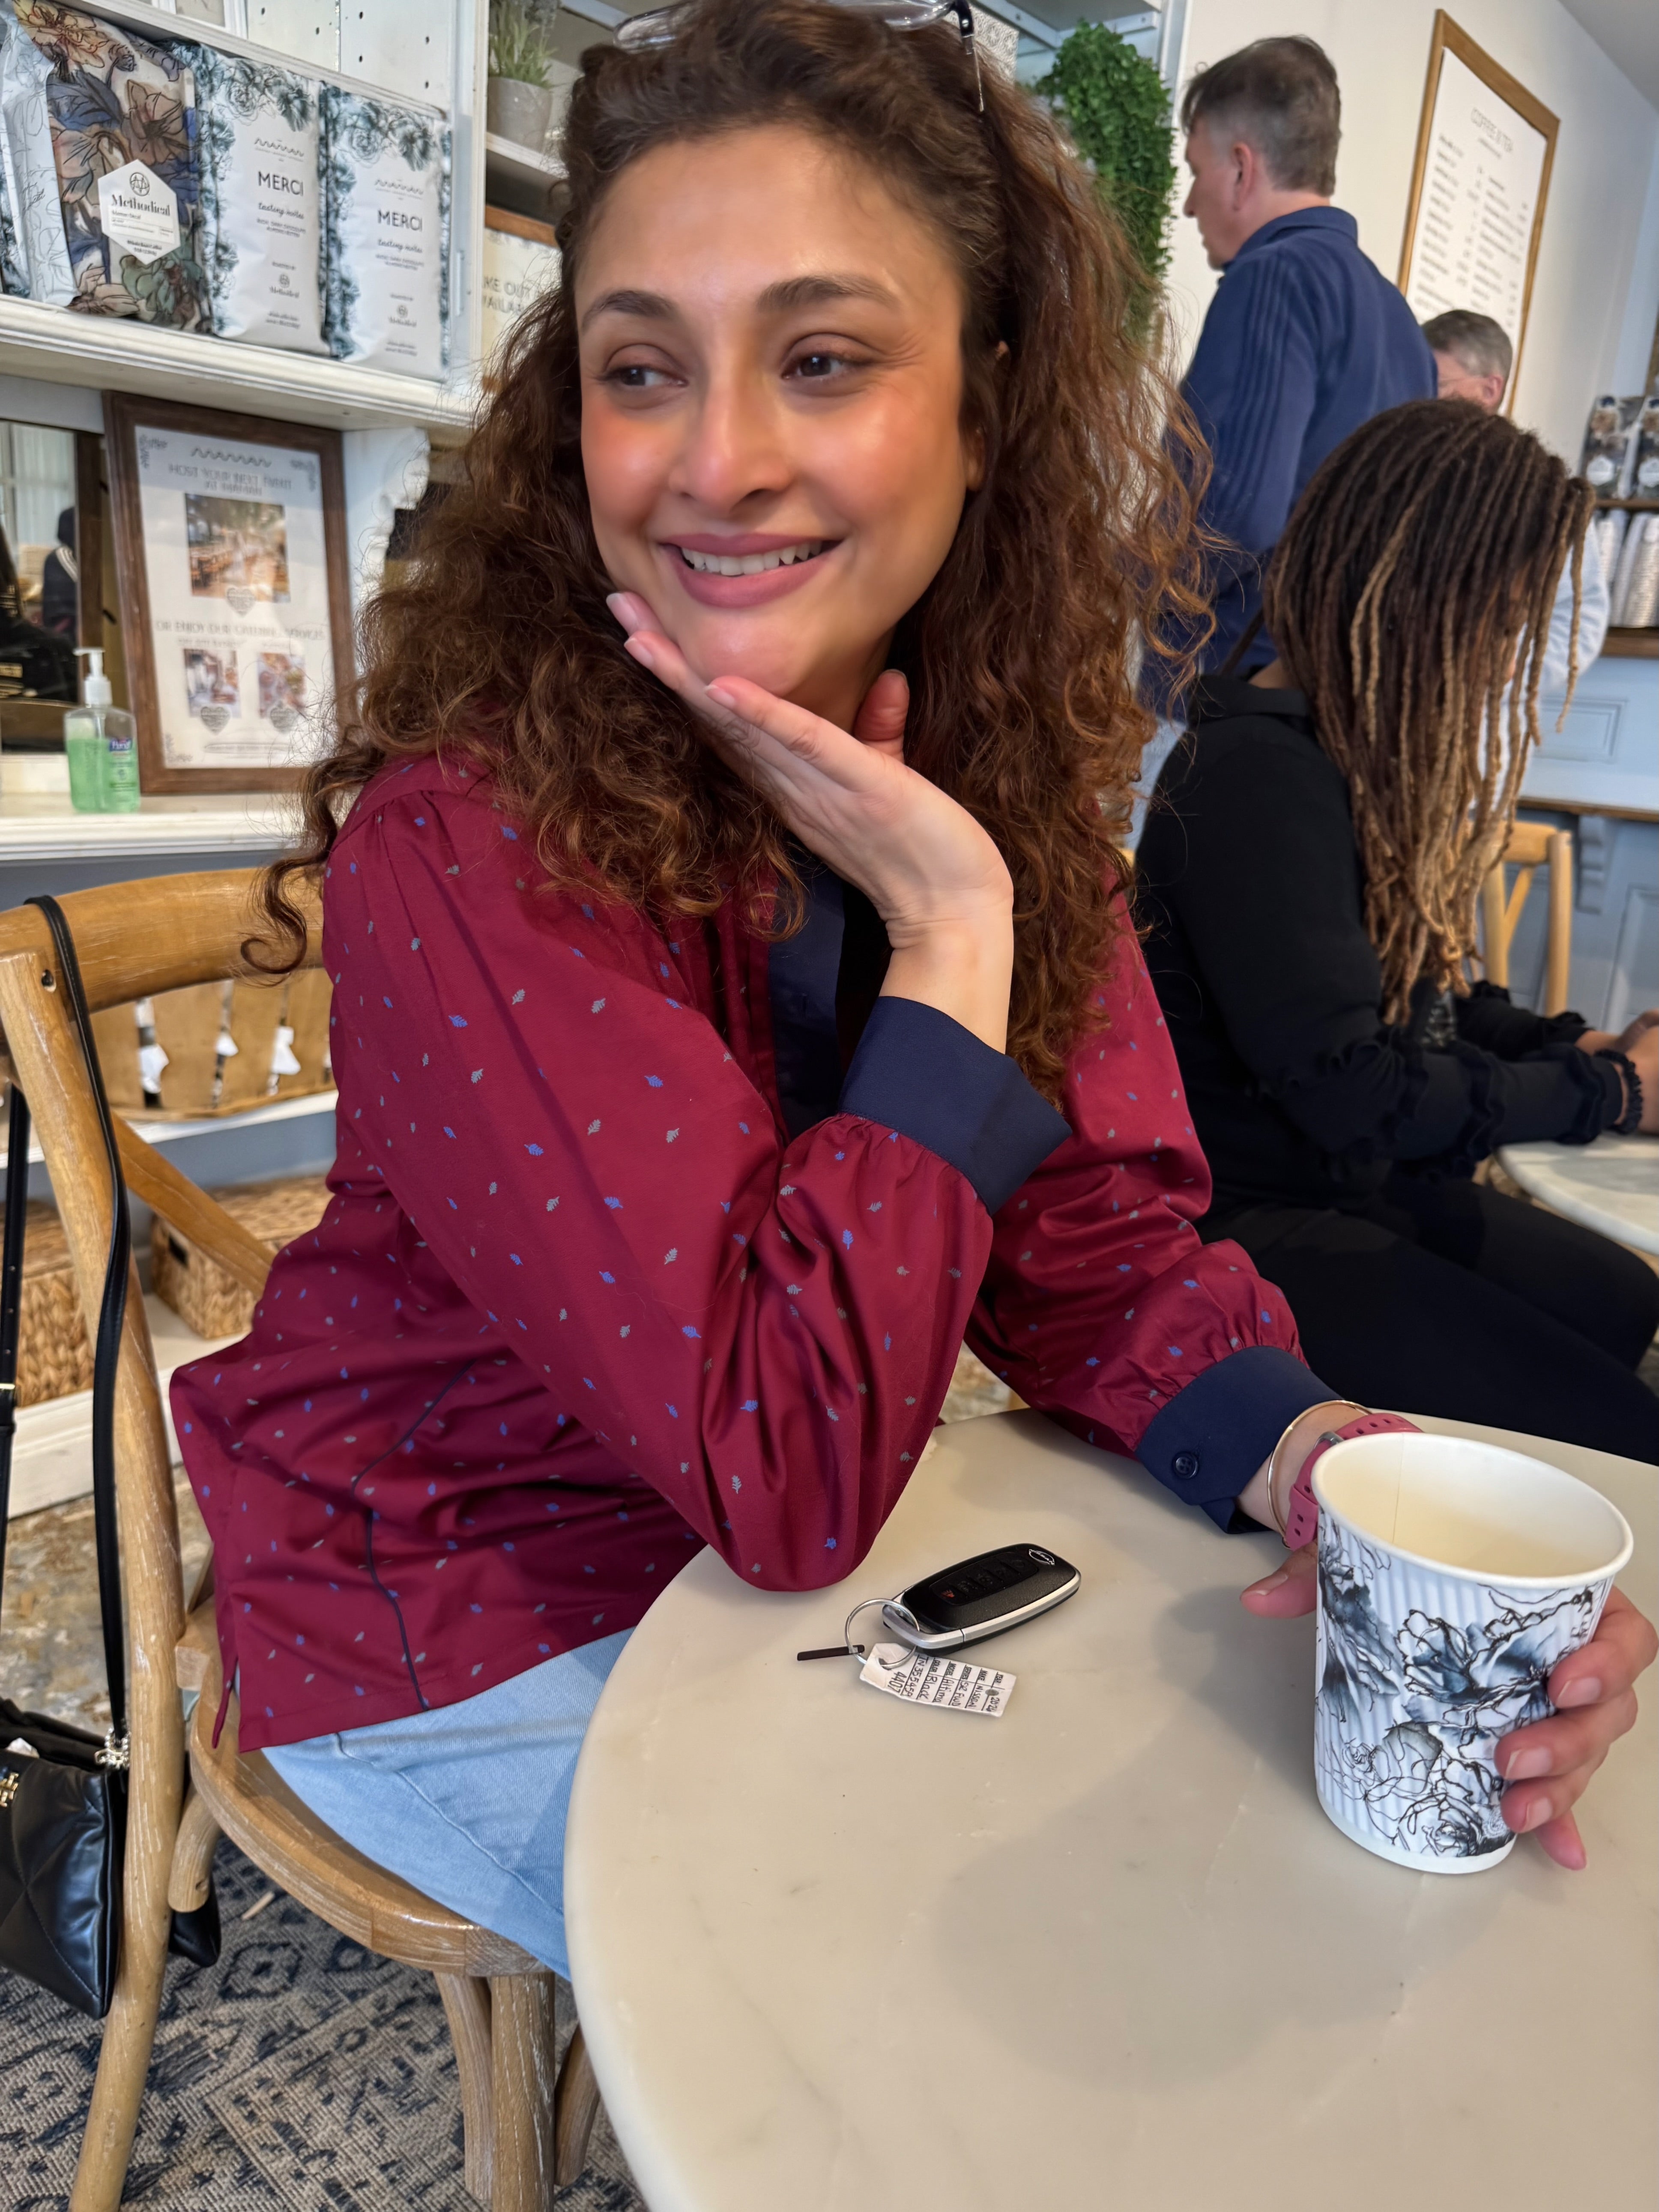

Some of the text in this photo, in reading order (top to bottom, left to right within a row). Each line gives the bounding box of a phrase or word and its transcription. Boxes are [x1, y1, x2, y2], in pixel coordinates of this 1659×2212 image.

[258, 170, 304, 196] MERCI
[111, 194, 170, 216] Methodical
[377, 209, 423, 232] MERCI
[919, 1659, 941, 1699] COLOR Black
[944, 1663, 957, 1676] MODEL
[961, 1666, 972, 1680] SERIES
[887, 1671, 907, 1693] 4407
